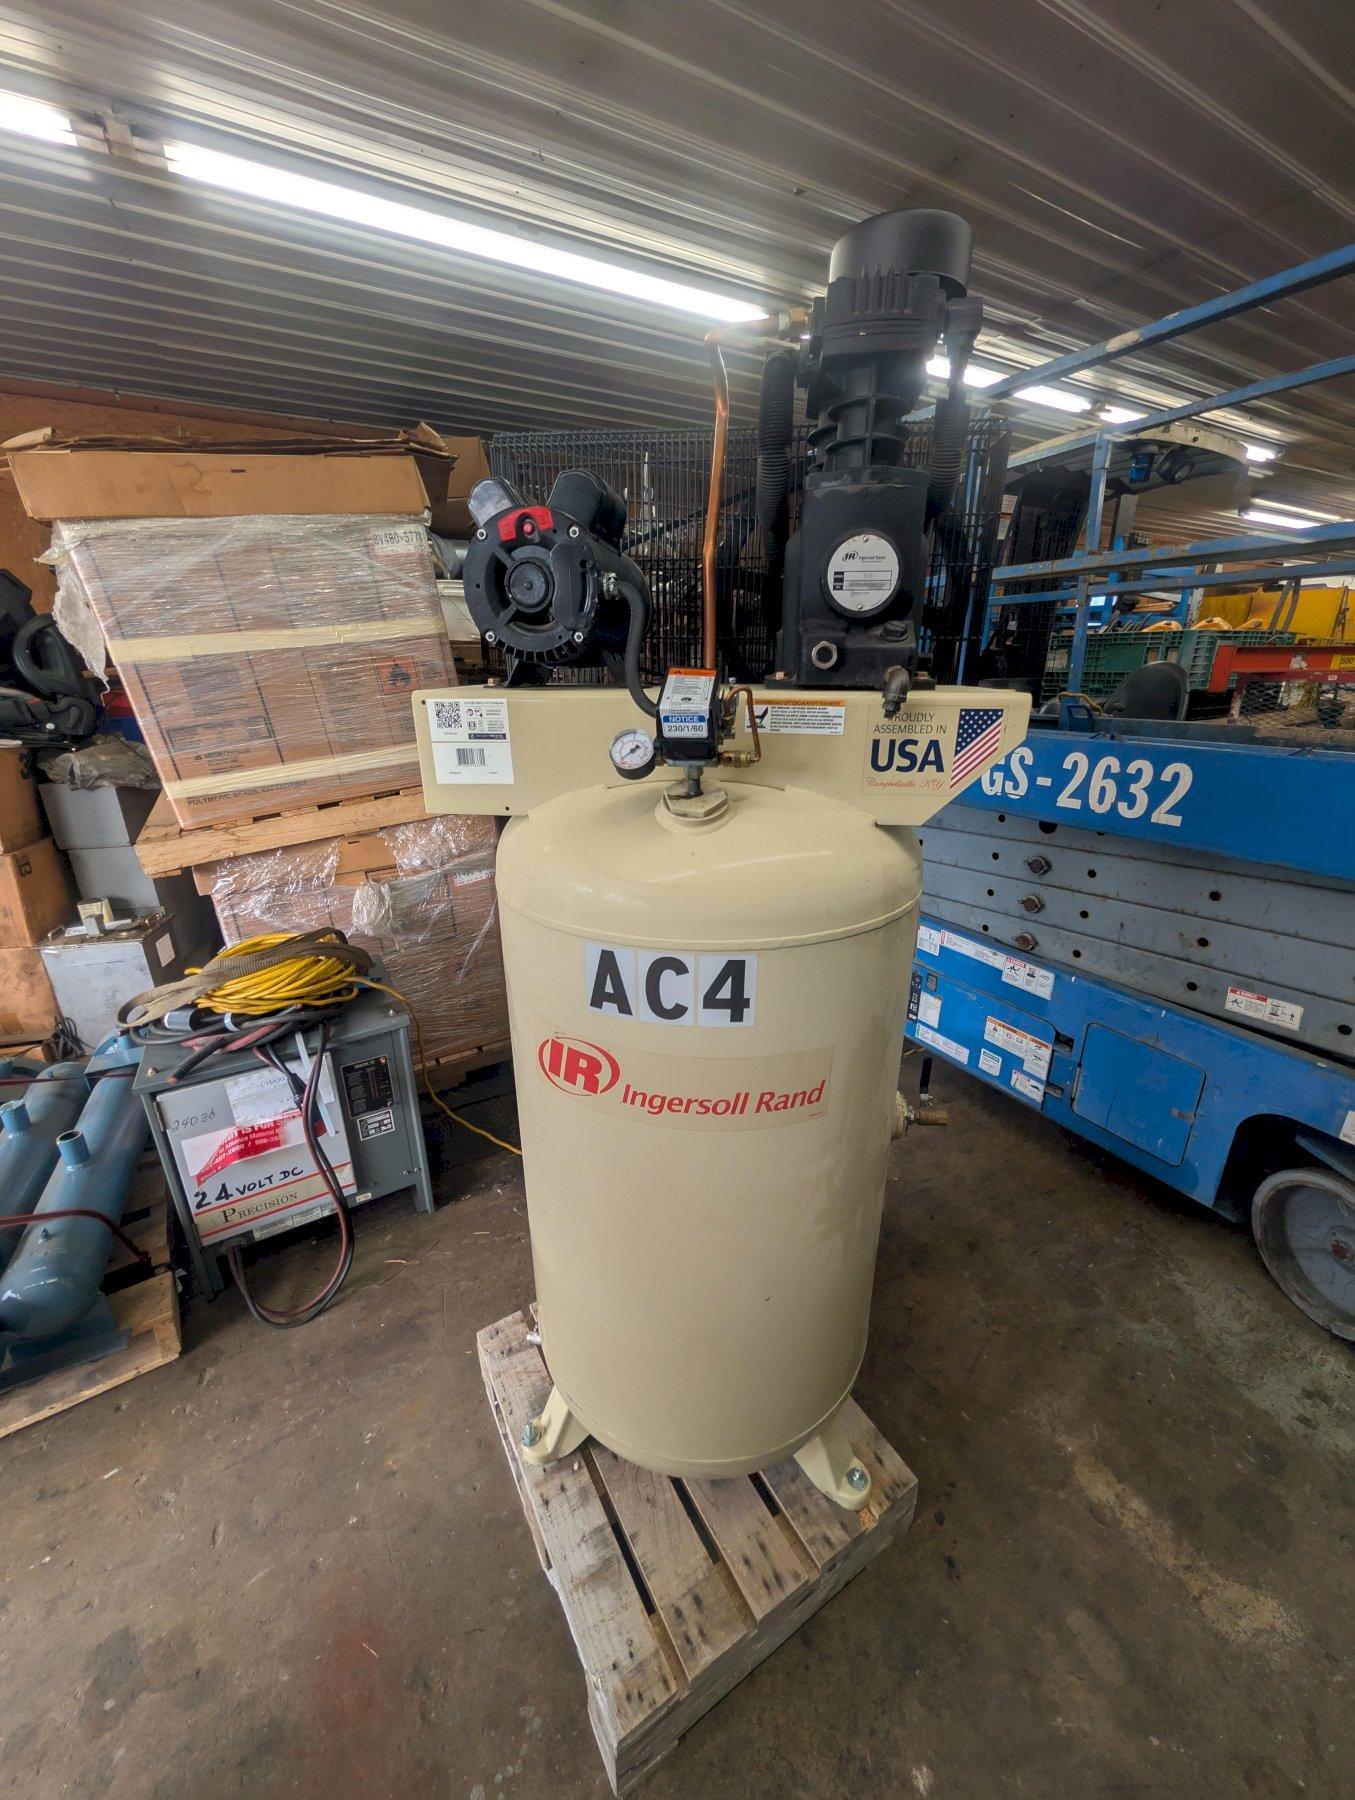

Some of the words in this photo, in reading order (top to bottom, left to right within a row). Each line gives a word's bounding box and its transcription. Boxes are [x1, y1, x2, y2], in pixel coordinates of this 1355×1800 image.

[669, 715, 699, 723] NOTICE
[890, 712, 935, 722] ROUDLY
[667, 725, 704, 733] 230/1/60
[873, 724, 933, 734] ASSEMBLED
[936, 725, 947, 734] IN
[871, 738, 944, 773] USA
[548, 1038, 603, 1095] IR
[621, 1083, 750, 1116] Ingersoll
[754, 1079, 826, 1114] Rand
[194, 1183, 234, 1210] 24
[235, 1174, 274, 1196] VOLT
[279, 1166, 304, 1181] DC
[220, 1192, 299, 1224] PRECISION
